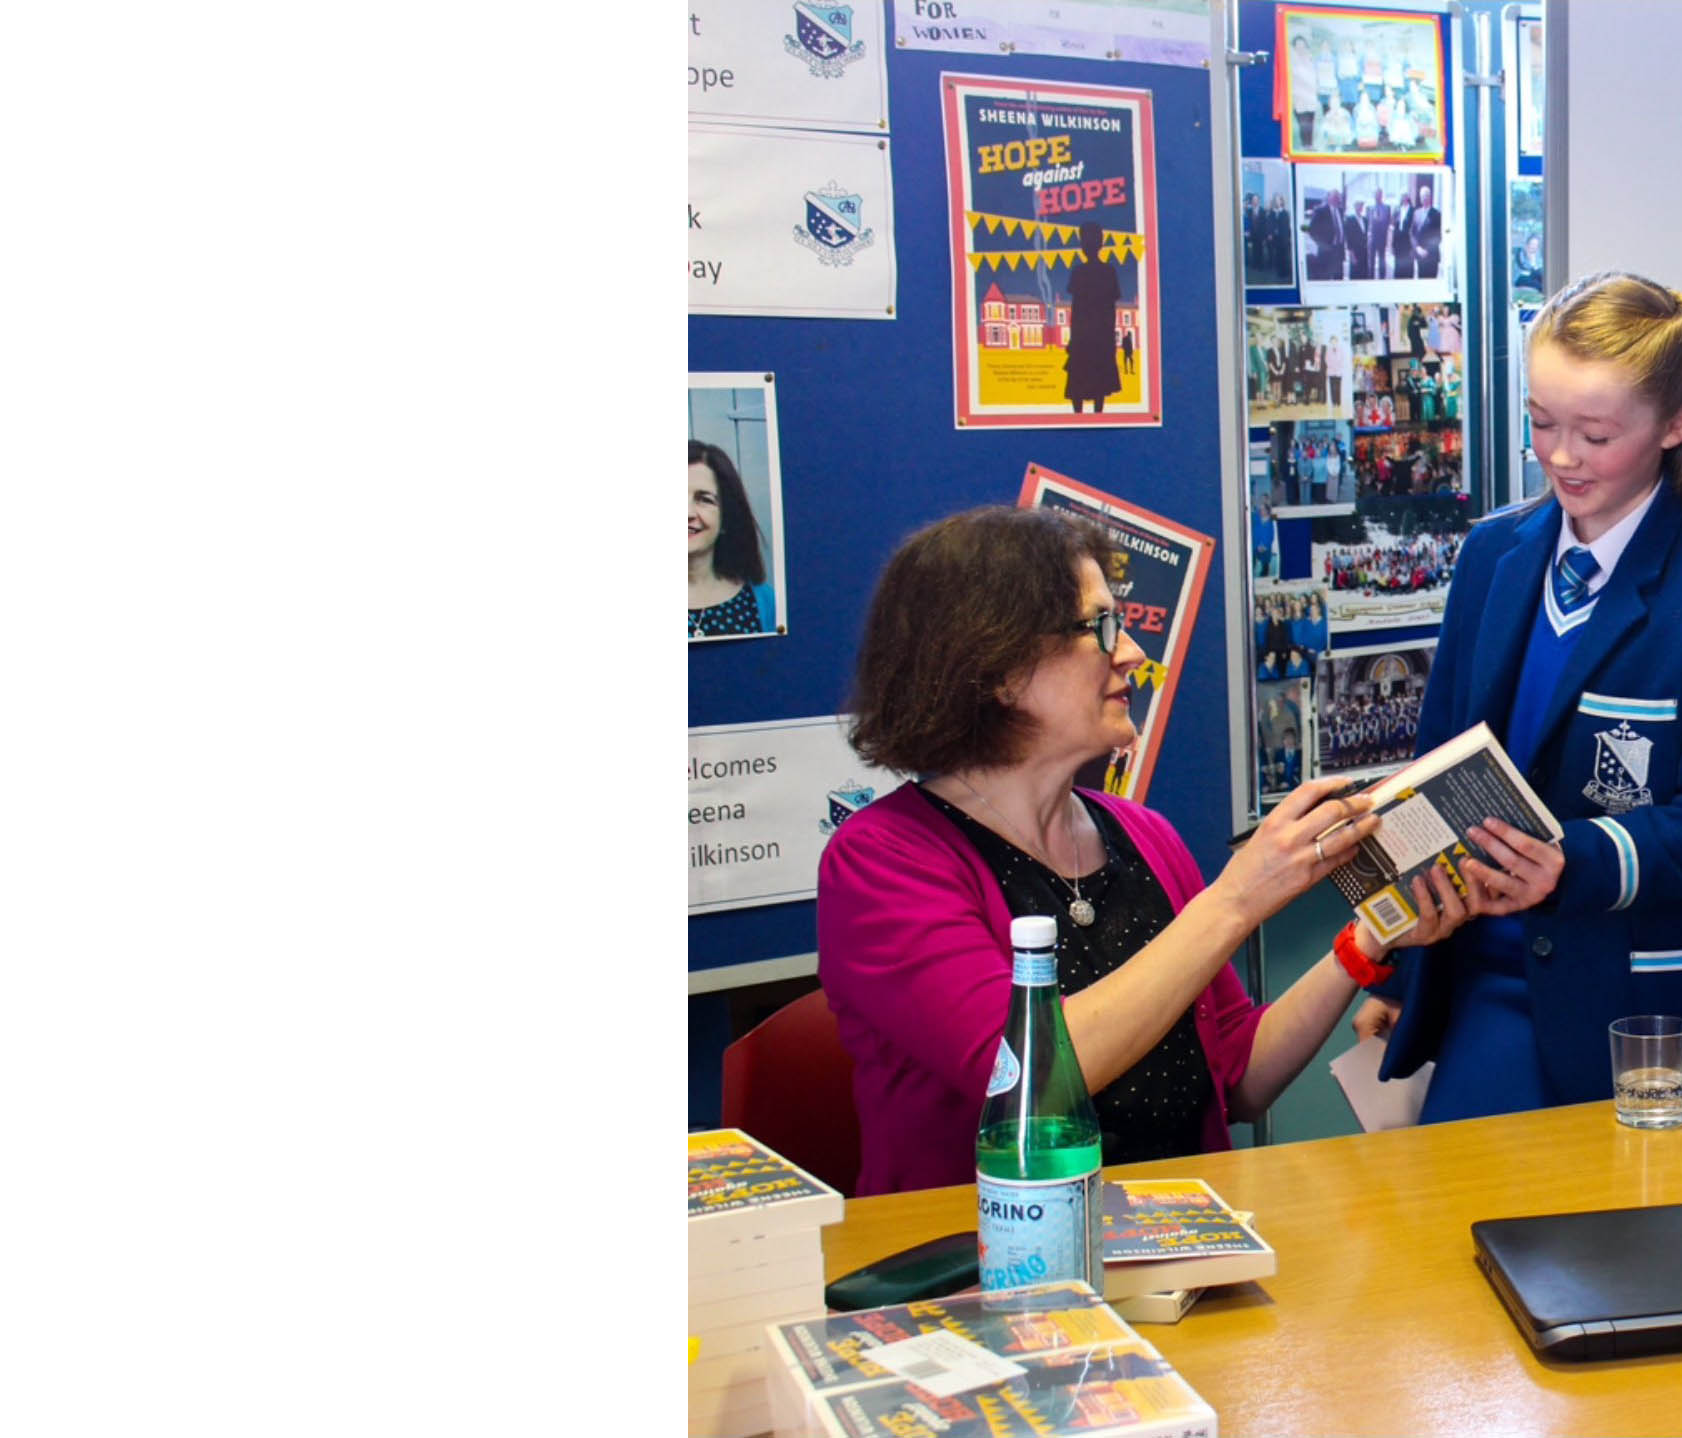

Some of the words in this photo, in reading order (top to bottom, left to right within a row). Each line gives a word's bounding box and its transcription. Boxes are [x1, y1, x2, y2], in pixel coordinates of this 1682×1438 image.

[914, 0, 957, 19] FOR
[912, 25, 987, 41] WOMEN
[978, 108, 1037, 126] SHEENA
[1041, 113, 1121, 133] WILKINSON
[977, 134, 1073, 174] HOPE
[1022, 160, 1085, 192] against
[1036, 176, 1128, 217] HOPE
[1108, 528, 1180, 567] WILKINSON
